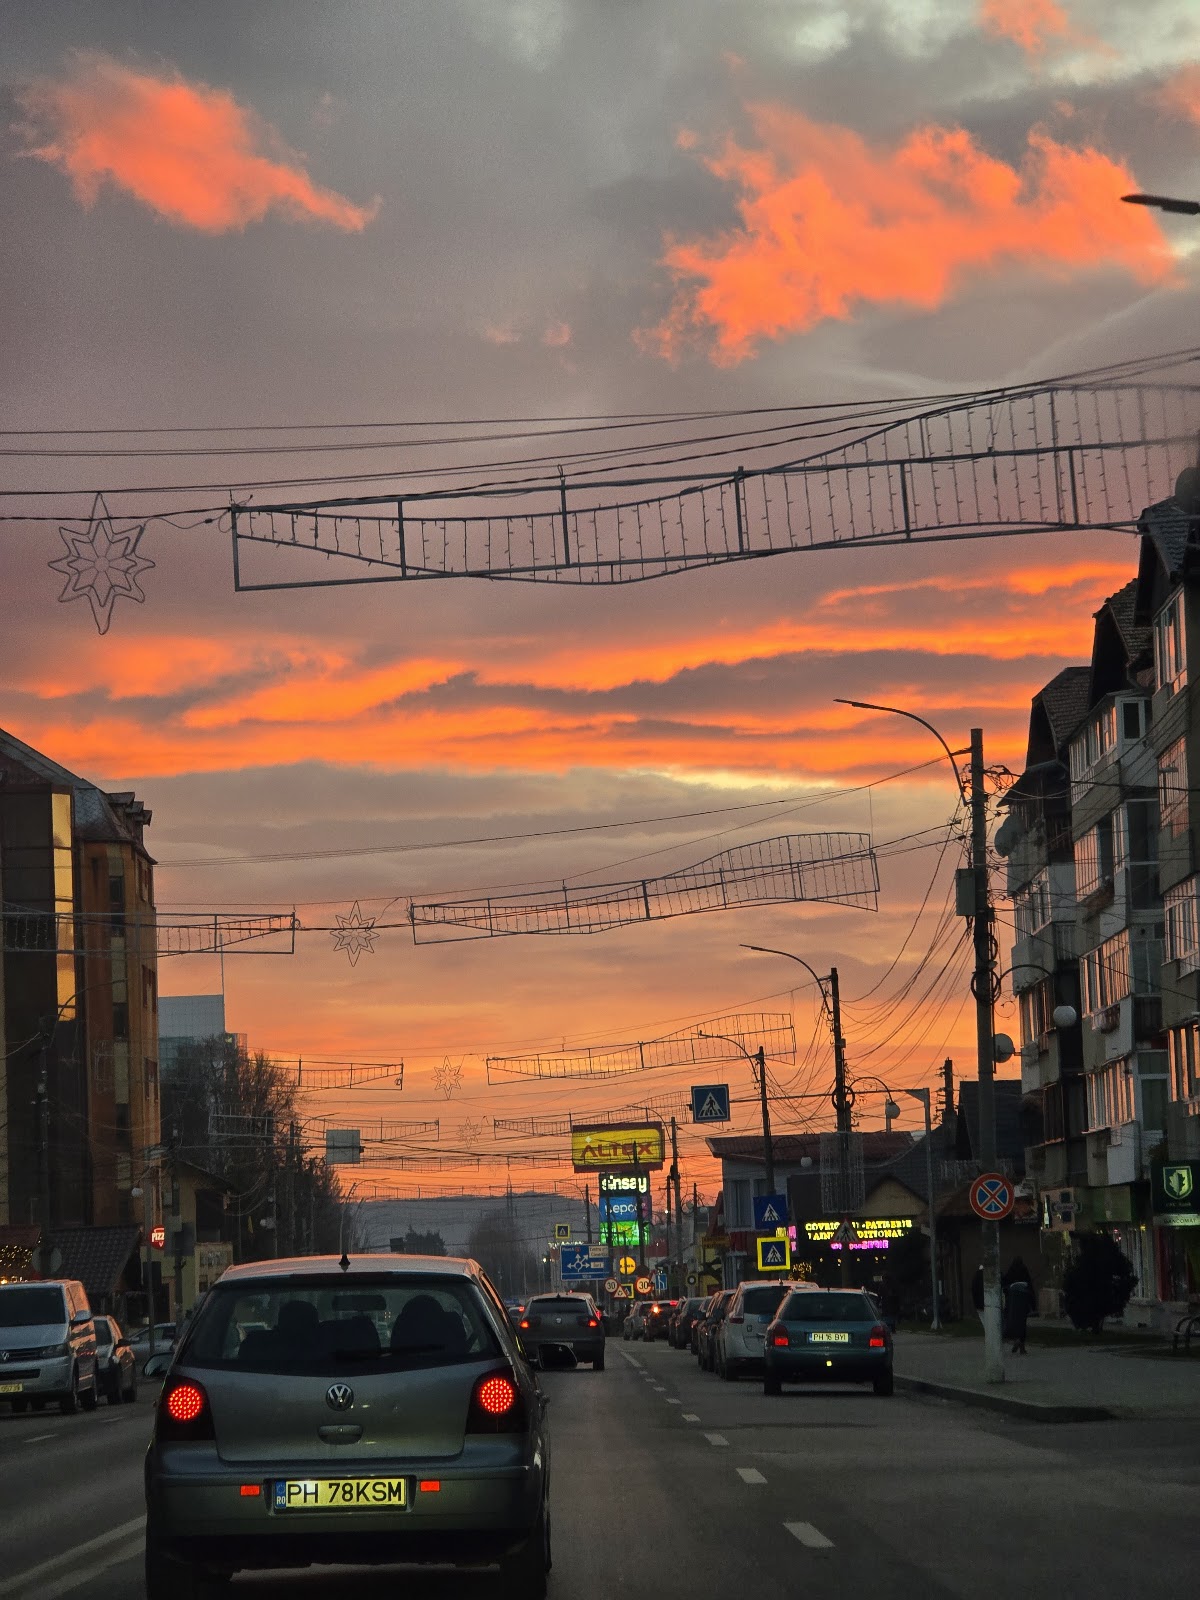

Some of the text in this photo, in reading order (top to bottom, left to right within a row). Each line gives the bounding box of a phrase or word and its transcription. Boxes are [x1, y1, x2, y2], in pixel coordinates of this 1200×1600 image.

[580, 1142, 653, 1158] ALTEX
[151, 1232, 165, 1242] PIZZ
[606, 1281, 616, 1290] 30
[639, 1281, 649, 1290] 30
[813, 1333, 824, 1341] PH
[287, 1481, 402, 1504] PH 78KSM
[276, 1495, 286, 1505] RO
